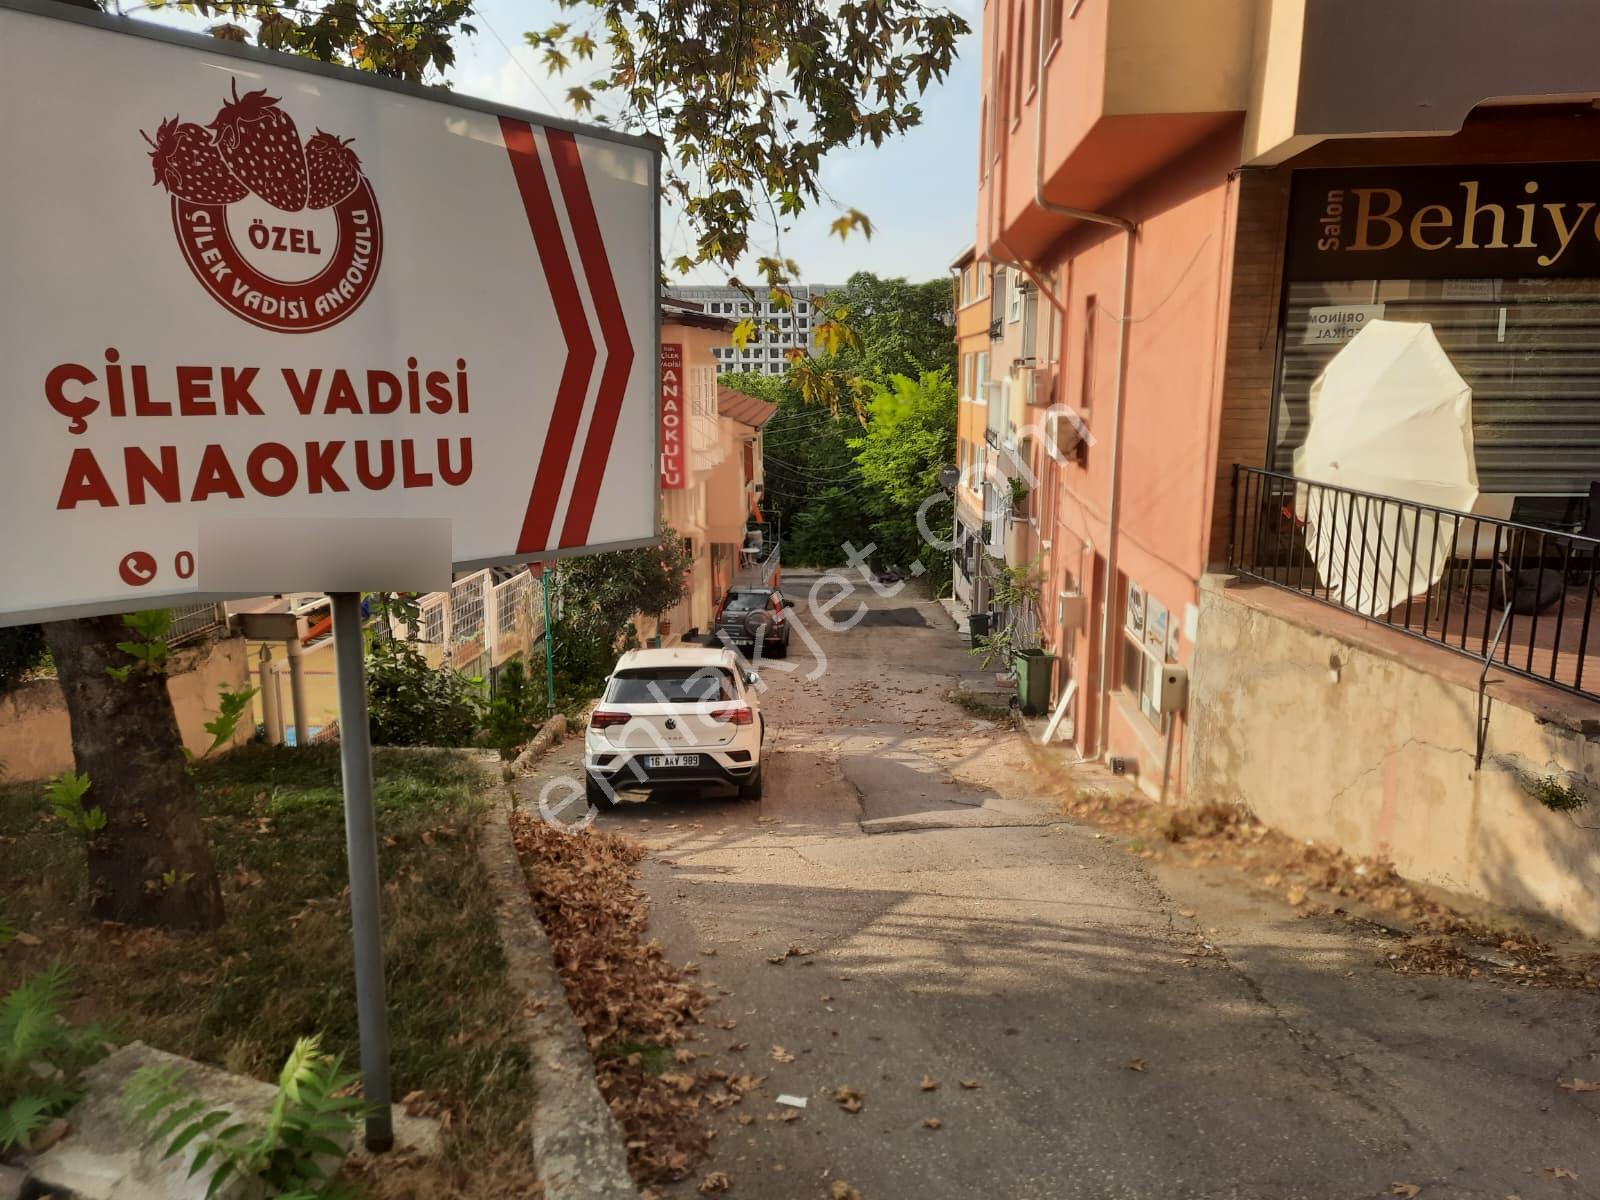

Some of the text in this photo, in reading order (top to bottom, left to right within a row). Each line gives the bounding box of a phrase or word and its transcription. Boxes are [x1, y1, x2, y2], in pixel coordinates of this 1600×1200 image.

[248, 218, 321, 255] ÖZEL
[1317, 189, 1345, 251] Salon
[1345, 181, 1600, 266] Behiy
[185, 209, 372, 320] ÇİLEK VADİSİ ANAOKULU
[44, 346, 471, 435] ÇİLEK VADİSİ
[662, 369, 680, 485] ANAOKULU
[56, 437, 473, 510] ANAOKULU
[651, 757, 660, 766] 16
